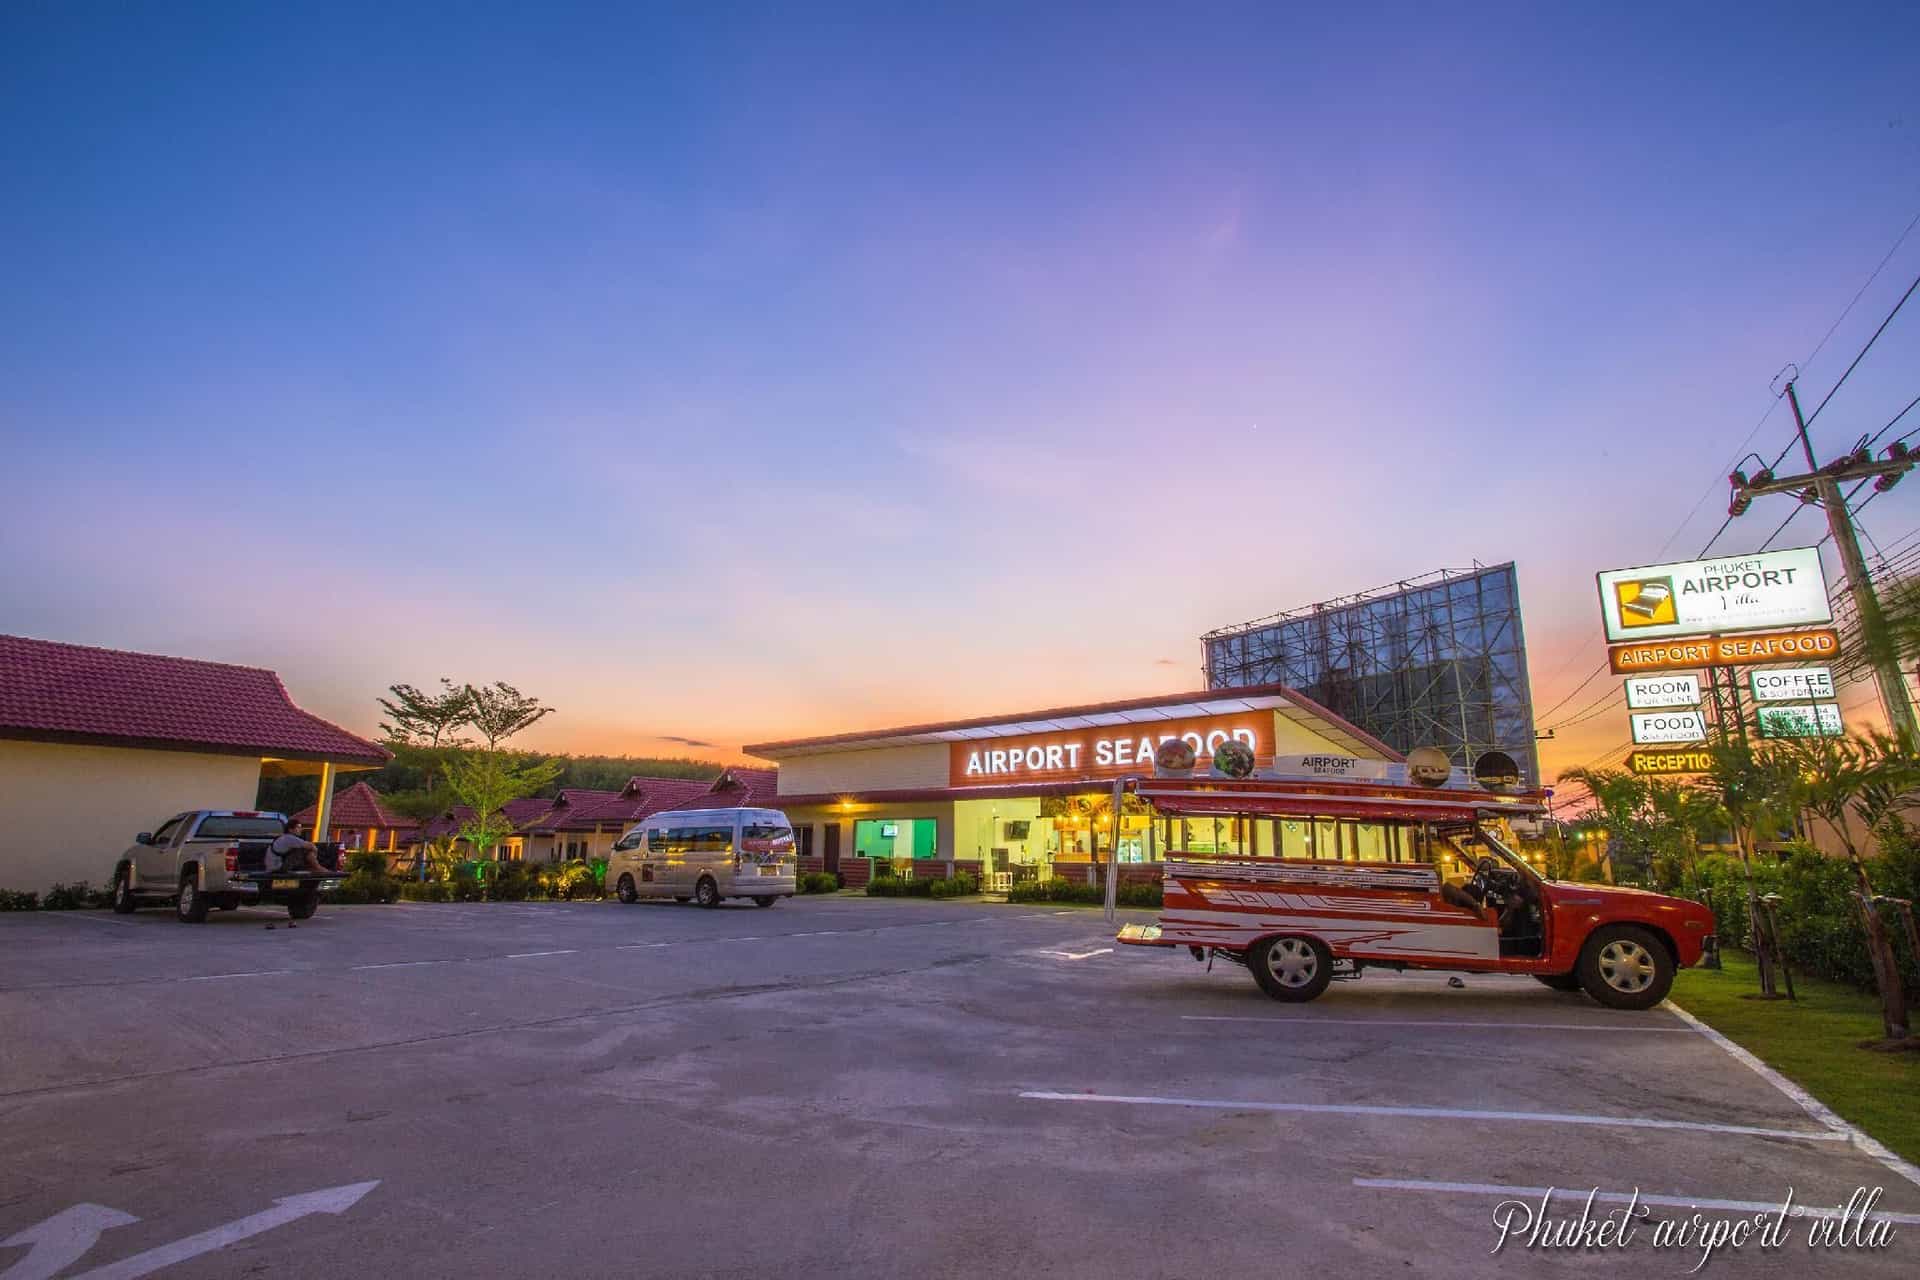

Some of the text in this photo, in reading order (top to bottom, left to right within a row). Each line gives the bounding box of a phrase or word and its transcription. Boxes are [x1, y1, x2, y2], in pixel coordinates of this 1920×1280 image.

[1703, 559, 1763, 576] PHUKET
[1682, 567, 1797, 595] AIRPORT
[1620, 635, 1832, 665] AIRPORT SEAFOOD
[1635, 681, 1691, 696] ROOM
[1756, 673, 1830, 689] COFFEE
[1770, 687, 1830, 699] SOFTDRNK
[1643, 717, 1695, 731] FOOD
[965, 743, 1082, 776] AIRPORT
[1301, 757, 1357, 769] AIRPORT
[1633, 752, 1715, 772] RECEPTIO
